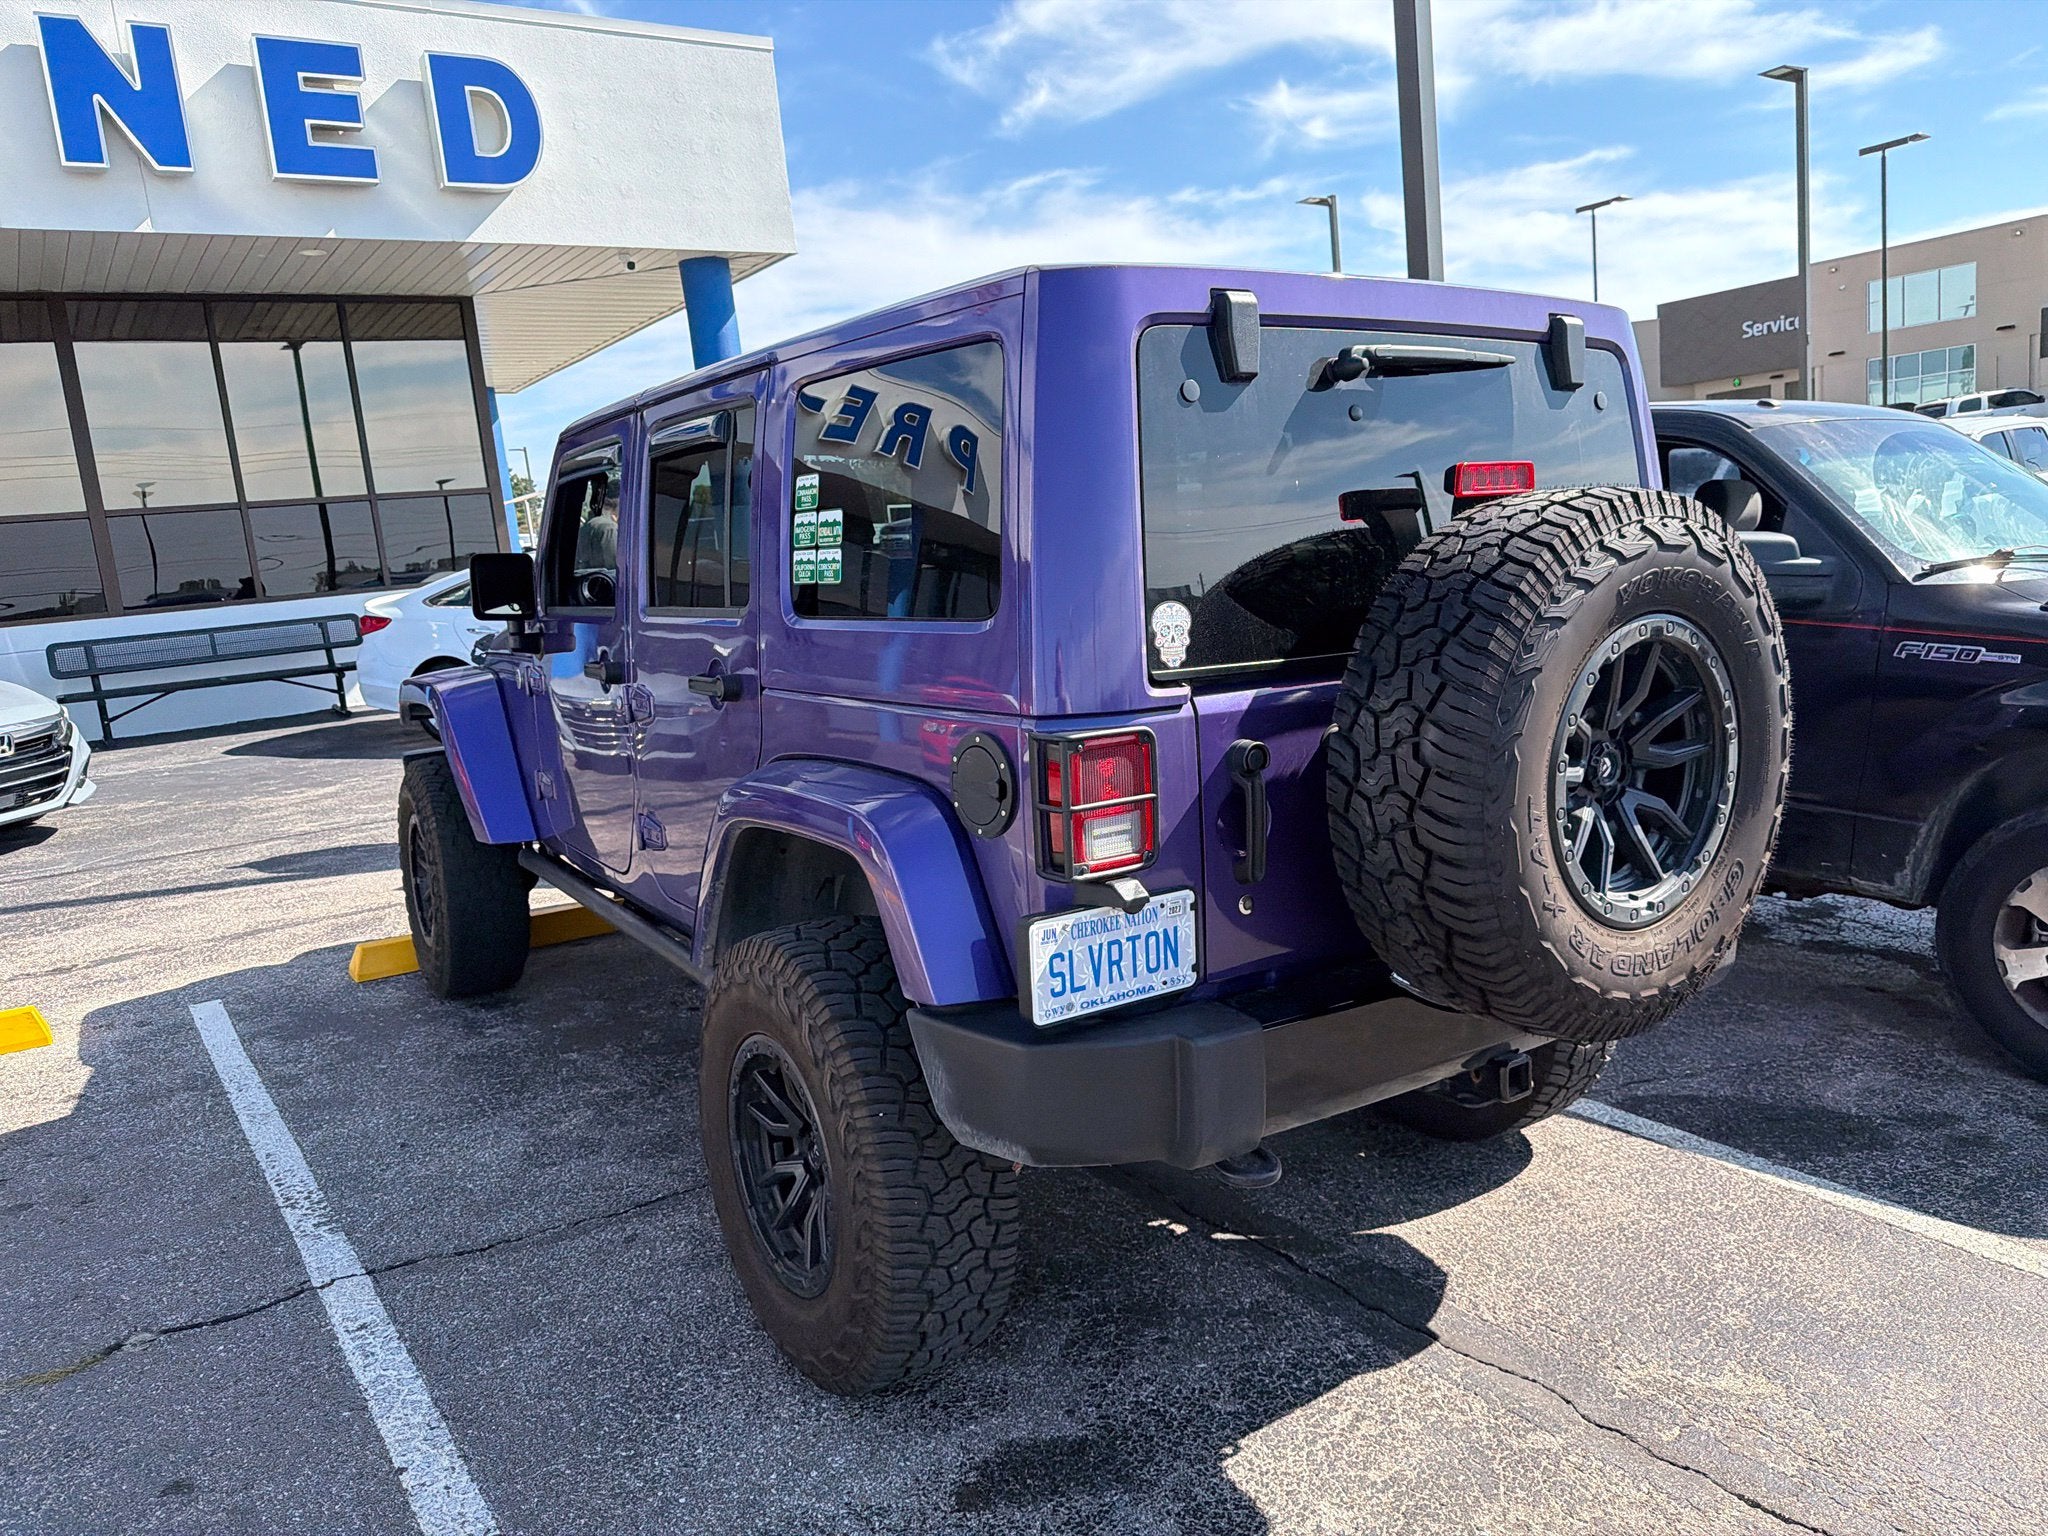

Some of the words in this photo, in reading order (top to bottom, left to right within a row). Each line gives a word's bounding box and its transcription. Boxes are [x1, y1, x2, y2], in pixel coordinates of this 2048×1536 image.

[1042, 927, 1057, 941] JUN
[1070, 914, 1121, 940] CHEROKEE
[1124, 906, 1159, 929] NATION
[1049, 925, 1180, 998] SLVRTON
[1080, 984, 1156, 1010] OKLAHOMA
